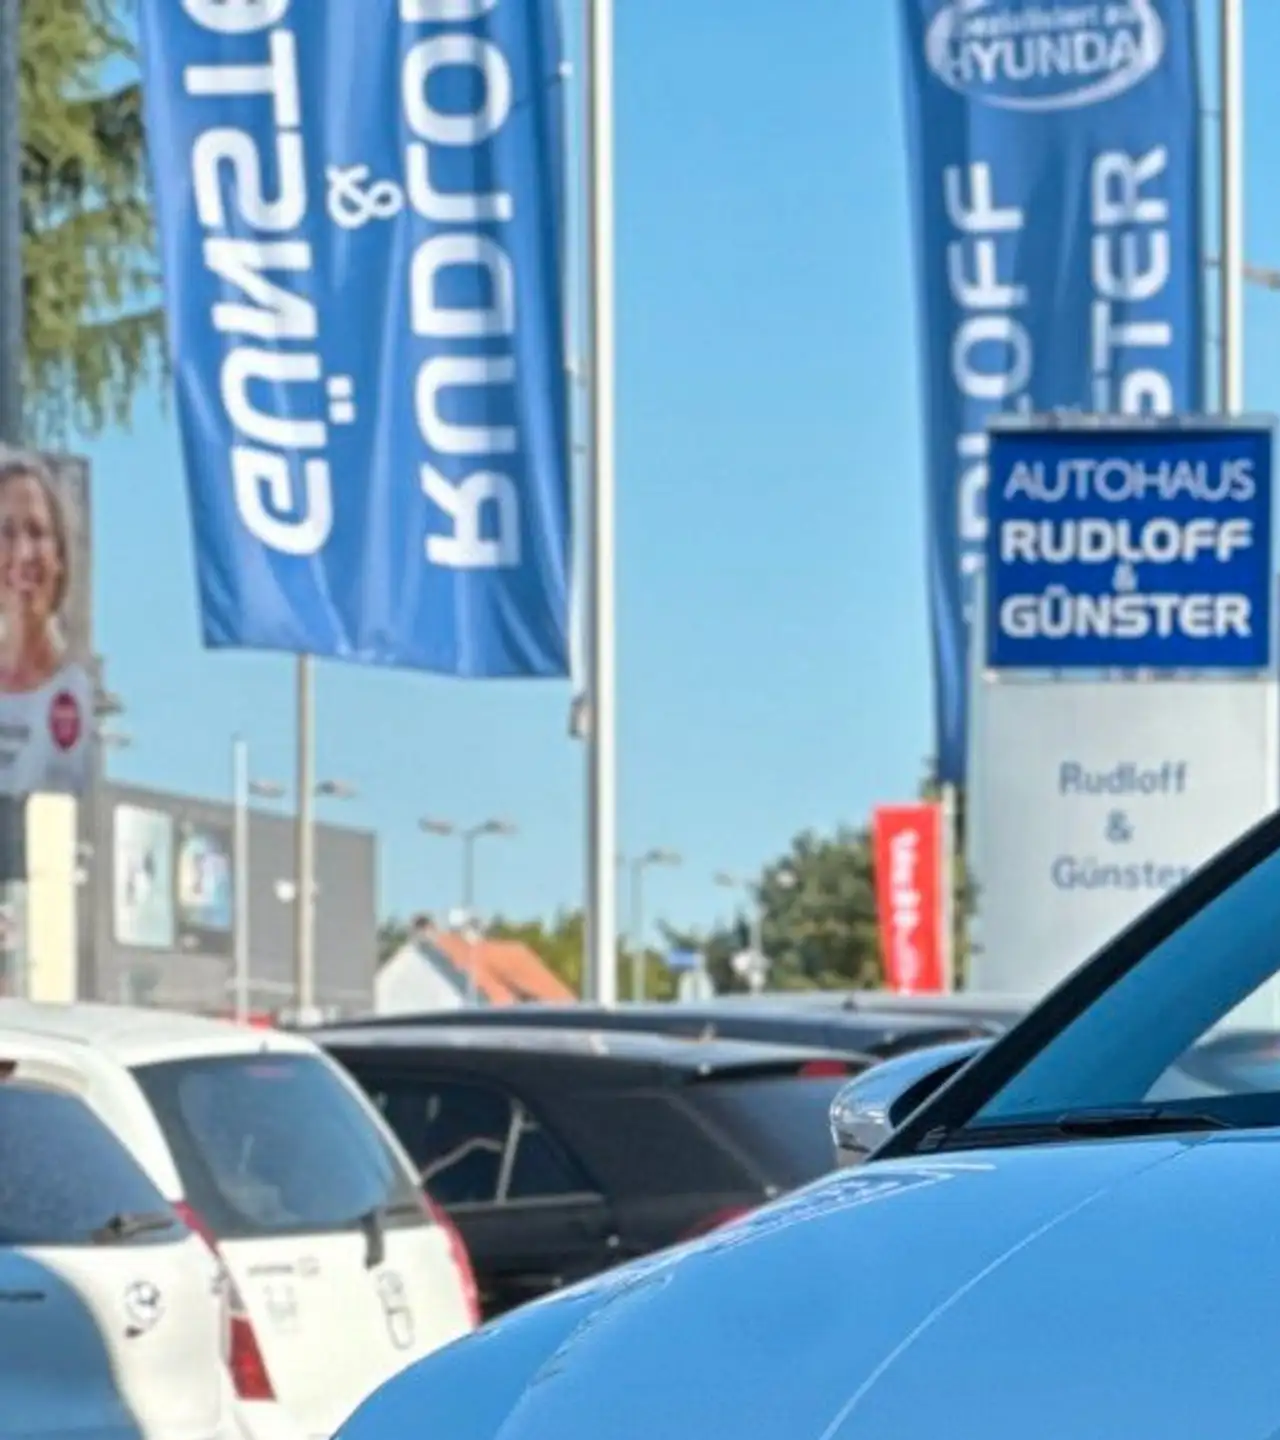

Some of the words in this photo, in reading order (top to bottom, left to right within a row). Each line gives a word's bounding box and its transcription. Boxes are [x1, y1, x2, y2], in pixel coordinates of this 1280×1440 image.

[1003, 458, 1257, 502] AUTOHAUS
[1000, 517, 1254, 564] RUDLOFF
[1000, 583, 1253, 639] GÜNSTER
[1058, 760, 1189, 796] Rudloff
[1104, 809, 1135, 845] &
